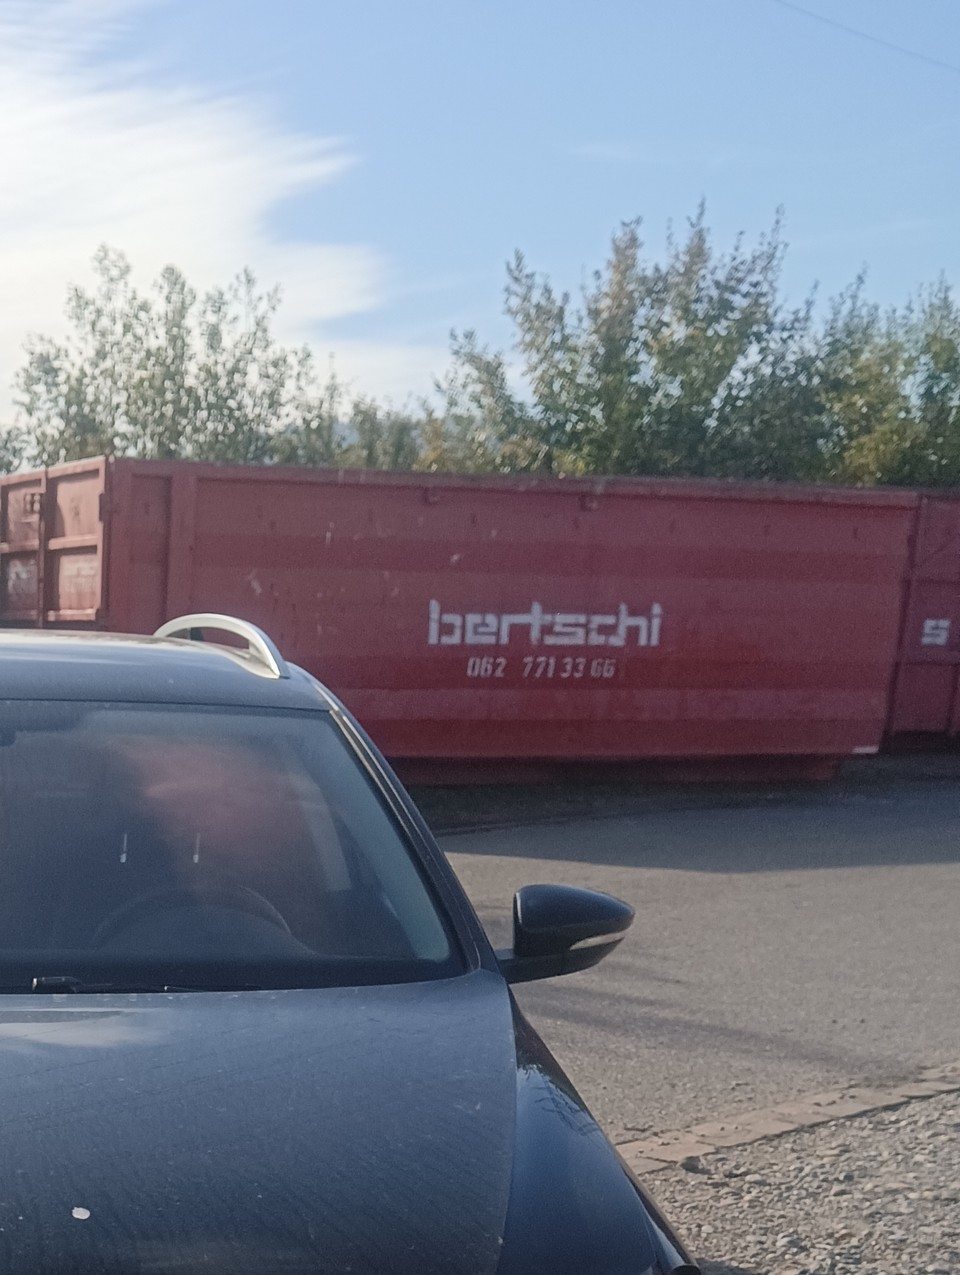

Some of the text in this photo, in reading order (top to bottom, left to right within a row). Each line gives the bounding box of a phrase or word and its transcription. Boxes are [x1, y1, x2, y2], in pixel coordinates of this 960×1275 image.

[428, 599, 662, 646] bertschi
[467, 656, 507, 678] 062
[523, 656, 556, 678] 771
[560, 657, 586, 678] 33
